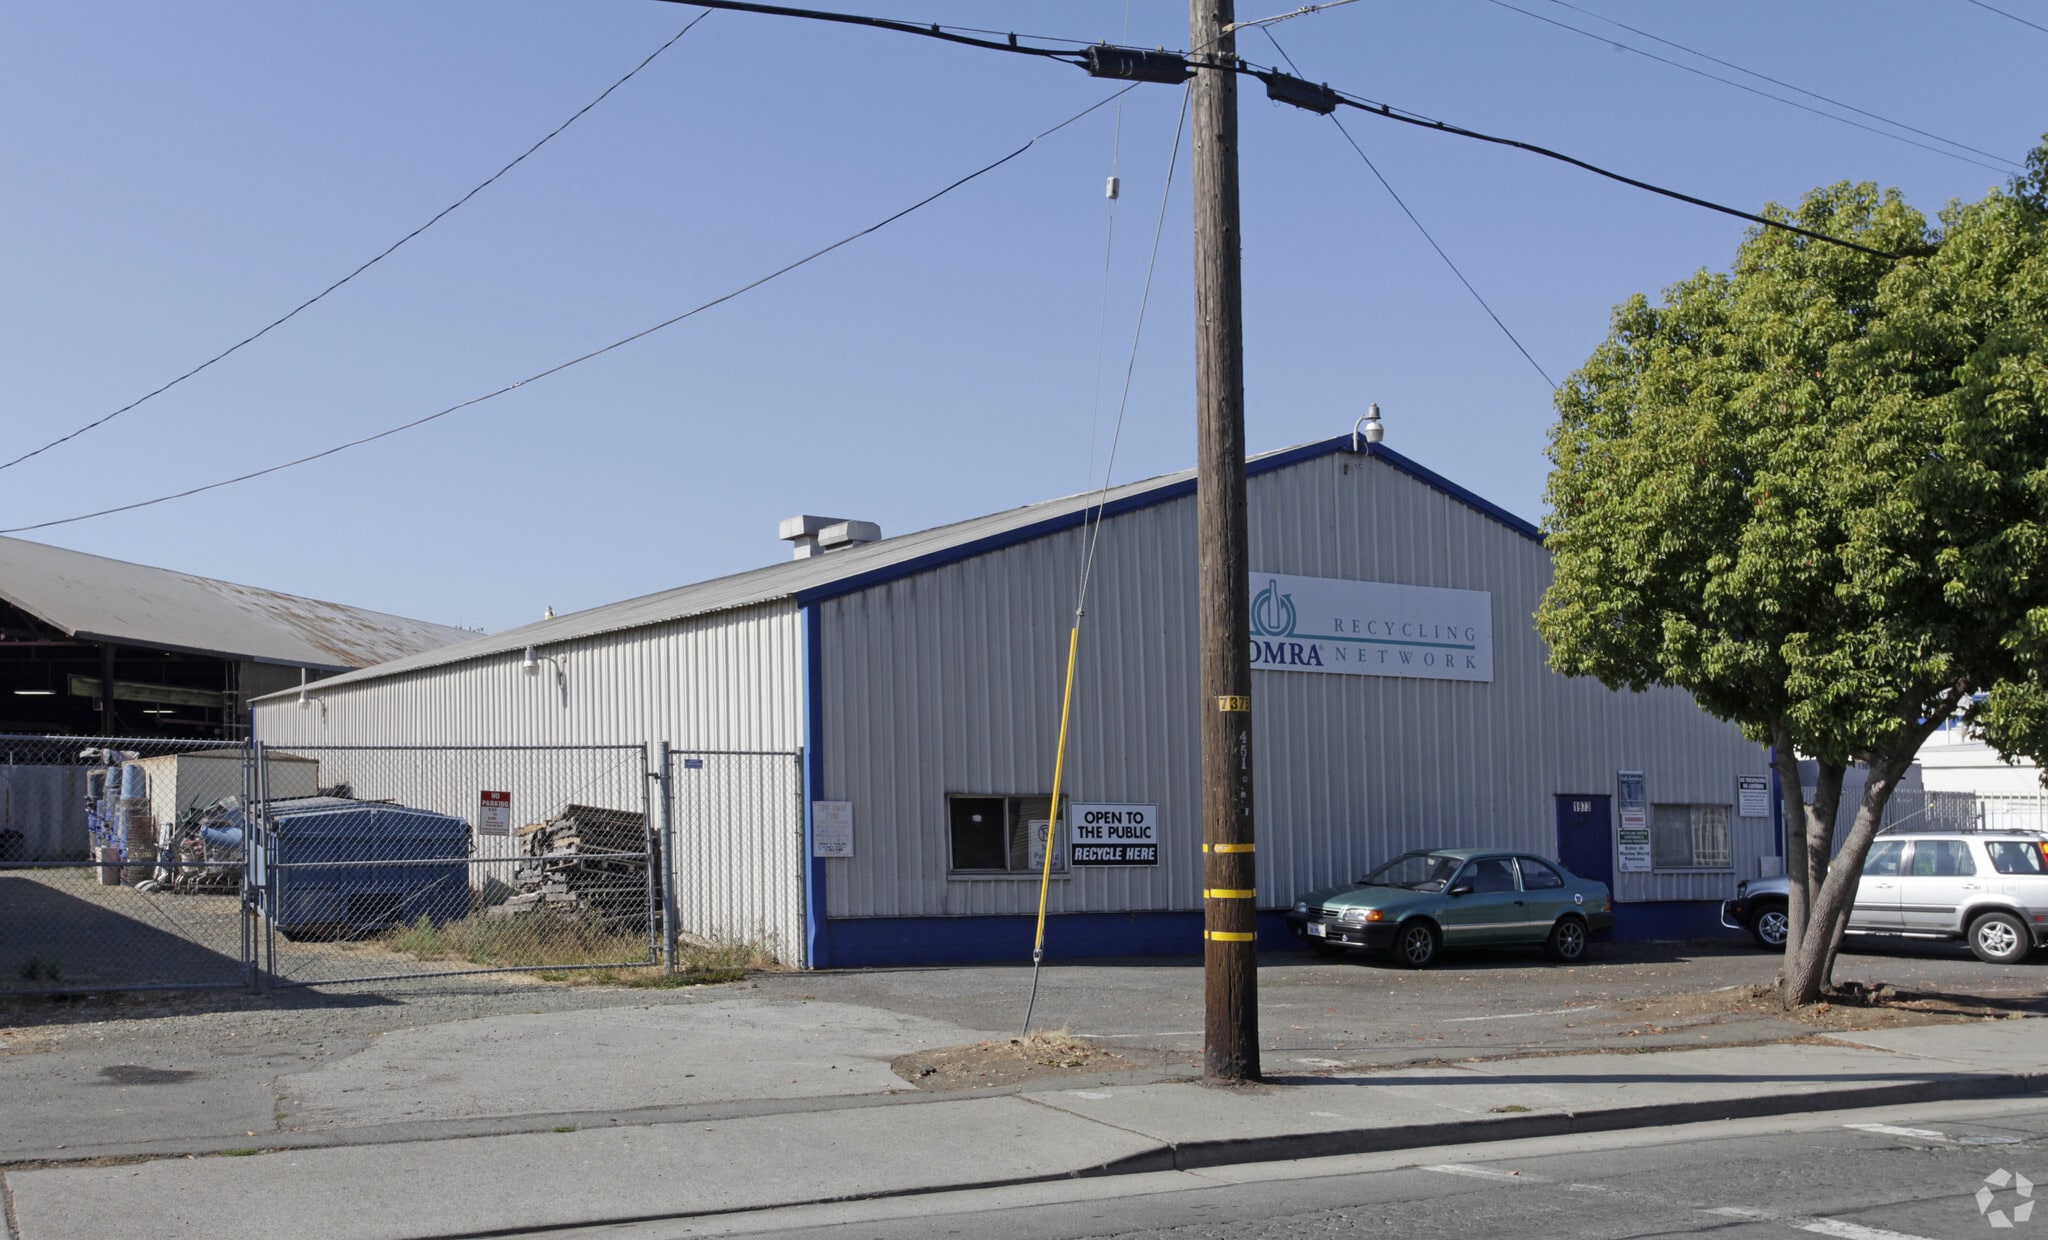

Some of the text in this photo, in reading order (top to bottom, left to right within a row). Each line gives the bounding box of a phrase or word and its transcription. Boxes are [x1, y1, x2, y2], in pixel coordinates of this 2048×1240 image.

[1334, 618, 1476, 641] RECYCLING
[1249, 640, 1324, 666] OMRA
[1335, 646, 1476, 669] NETWORK
[1084, 811, 1144, 824] OPEN TO
[1078, 826, 1152, 839] THE PUBLIC
[1075, 847, 1155, 860] RECYCLE HERE
